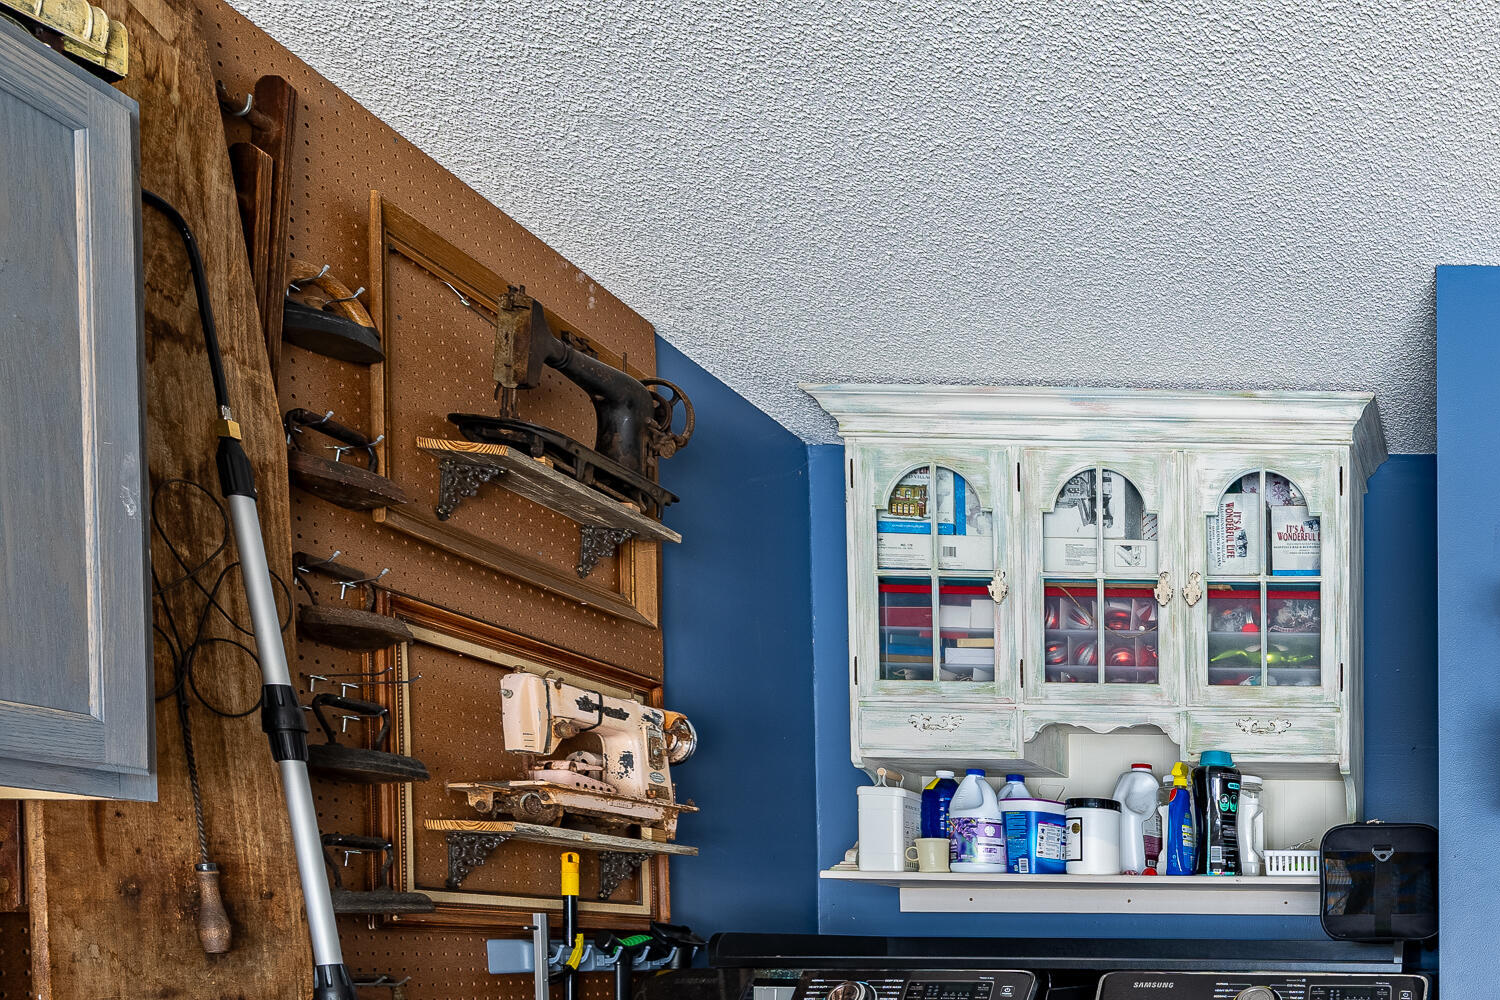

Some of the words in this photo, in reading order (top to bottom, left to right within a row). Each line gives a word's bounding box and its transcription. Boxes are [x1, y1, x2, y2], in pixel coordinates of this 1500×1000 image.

[1225, 501, 1234, 543] WONDERFUL
[1233, 511, 1242, 524] IT'S
[1286, 524, 1298, 533] IT'S
[1298, 524, 1305, 533] A
[1277, 531, 1316, 541] WONDERFUL
[1226, 544, 1235, 559] LIFE
